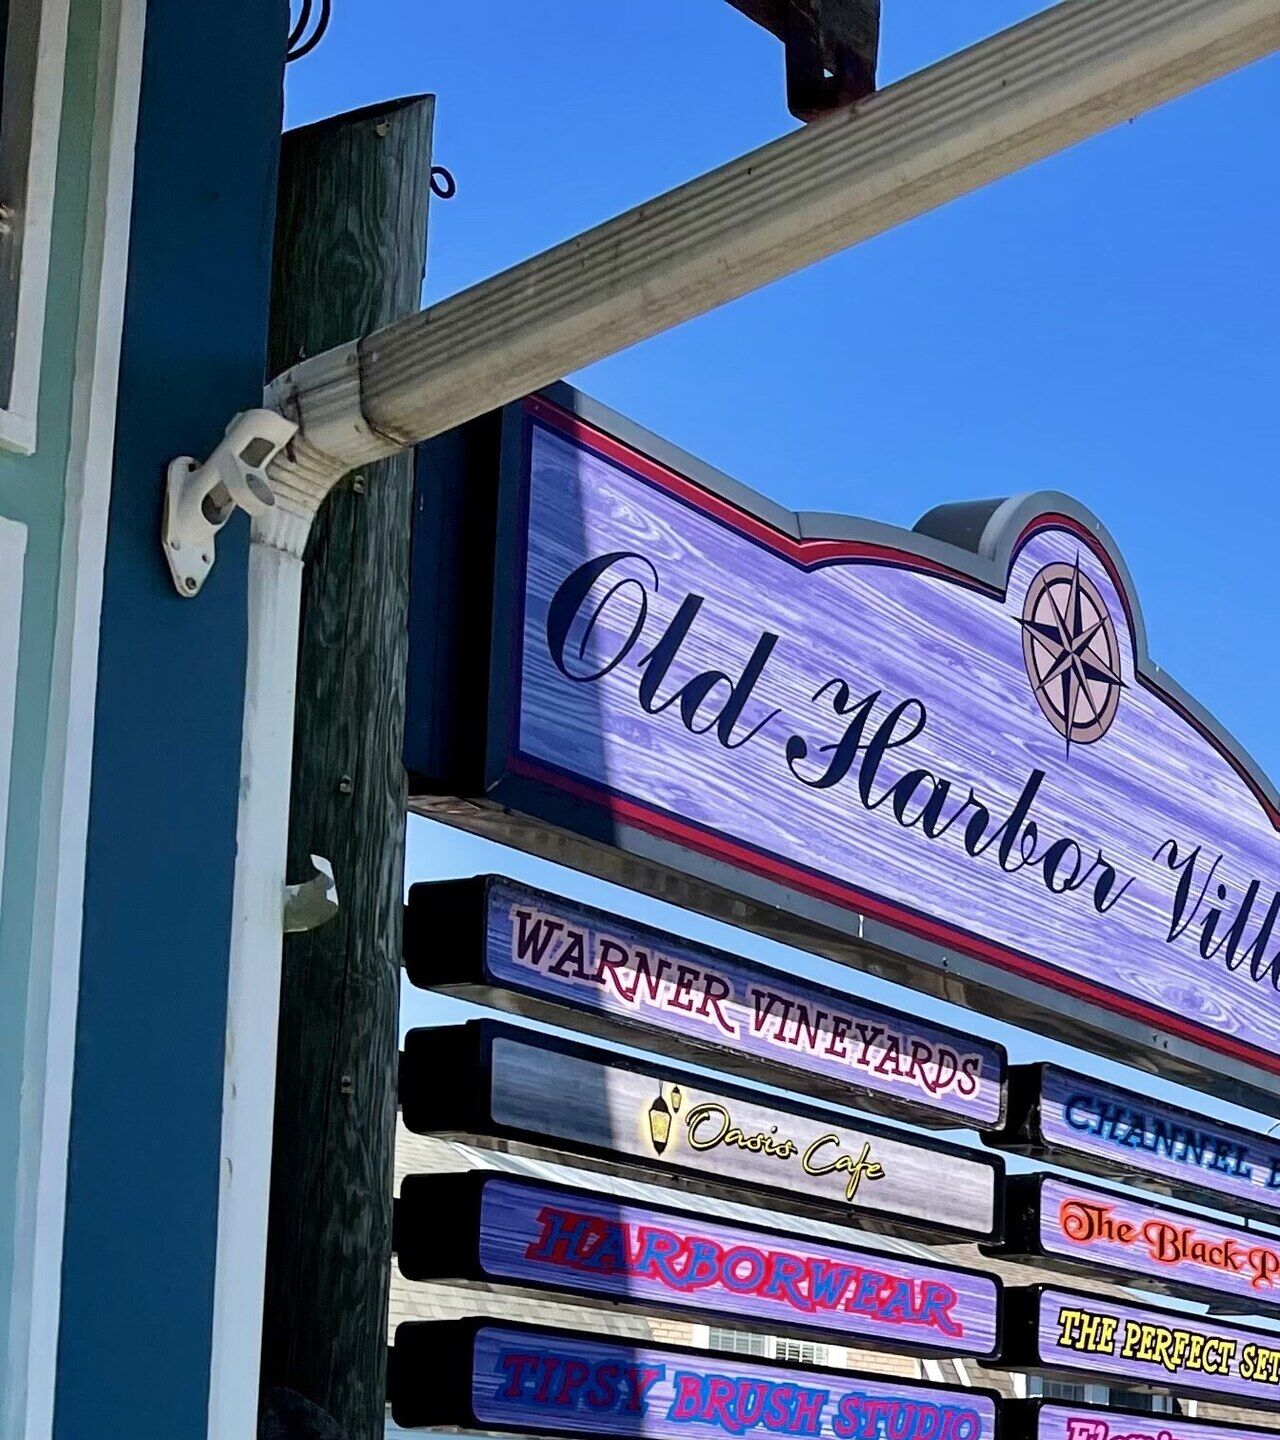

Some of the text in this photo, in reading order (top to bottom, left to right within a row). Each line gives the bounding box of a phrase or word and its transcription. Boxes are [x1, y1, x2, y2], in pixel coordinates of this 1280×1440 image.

[547, 552, 782, 748] Old
[787, 678, 1134, 912] Harbor
[516, 910, 982, 1097] WARNER VINEYARDS
[685, 1103, 884, 1199] Oasis Cafe
[1064, 1094, 1254, 1179] CHANNEL
[525, 1207, 962, 1337] HARBORWEAR
[1061, 1200, 1134, 1242] The
[1144, 1220, 1242, 1270] Black
[1058, 1309, 1117, 1354] THE
[1122, 1323, 1235, 1371] PERFECT
[497, 1350, 665, 1414] TIPSY
[668, 1370, 831, 1438] BRUSH
